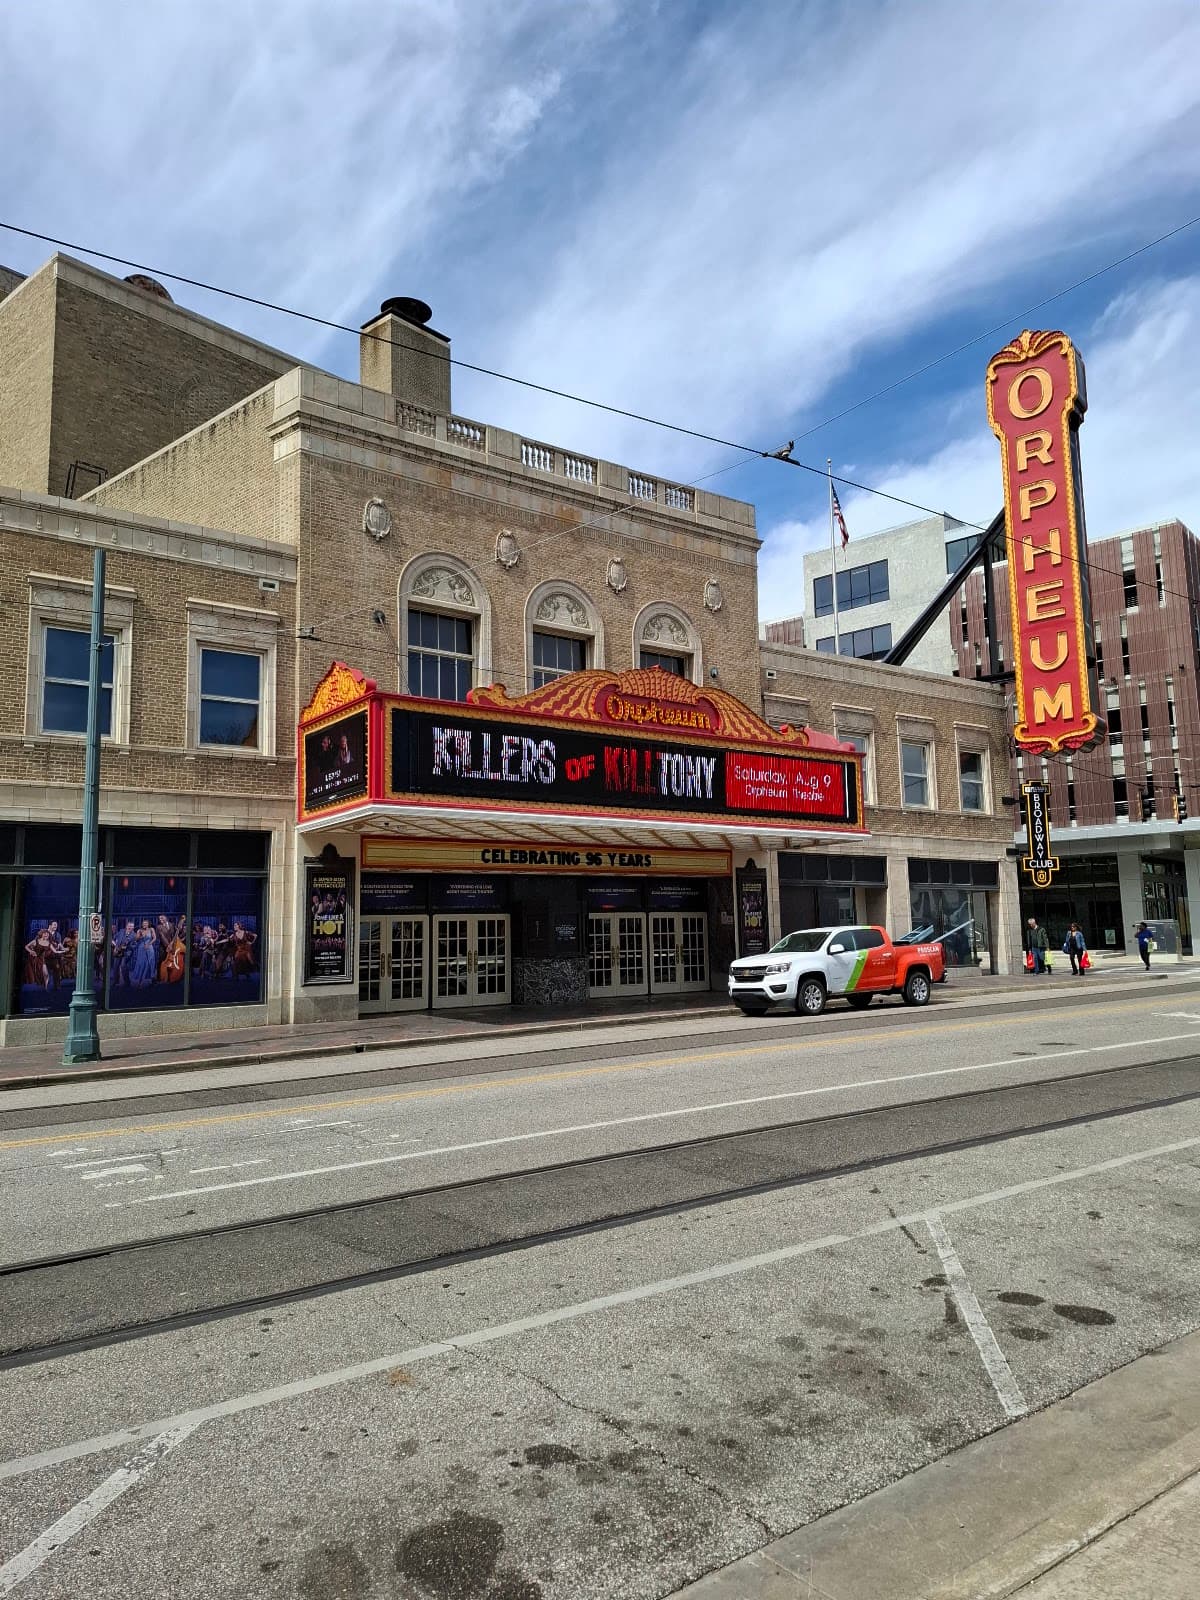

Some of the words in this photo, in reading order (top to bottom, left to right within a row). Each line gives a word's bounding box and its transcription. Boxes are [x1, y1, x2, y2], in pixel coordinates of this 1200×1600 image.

[1007, 366, 1073, 726] ORPHEUM
[432, 727, 555, 784] KILLERS
[564, 754, 595, 781] OF
[823, 774, 831, 788] 9
[1033, 793, 1044, 858] BROADWAY
[481, 848, 580, 866] CELEBRATING
[586, 851, 602, 866] 96
[607, 852, 651, 867] YEARS
[1029, 860, 1054, 868] CLUB
[313, 920, 345, 935] HOT
[745, 915, 762, 927] HOT
